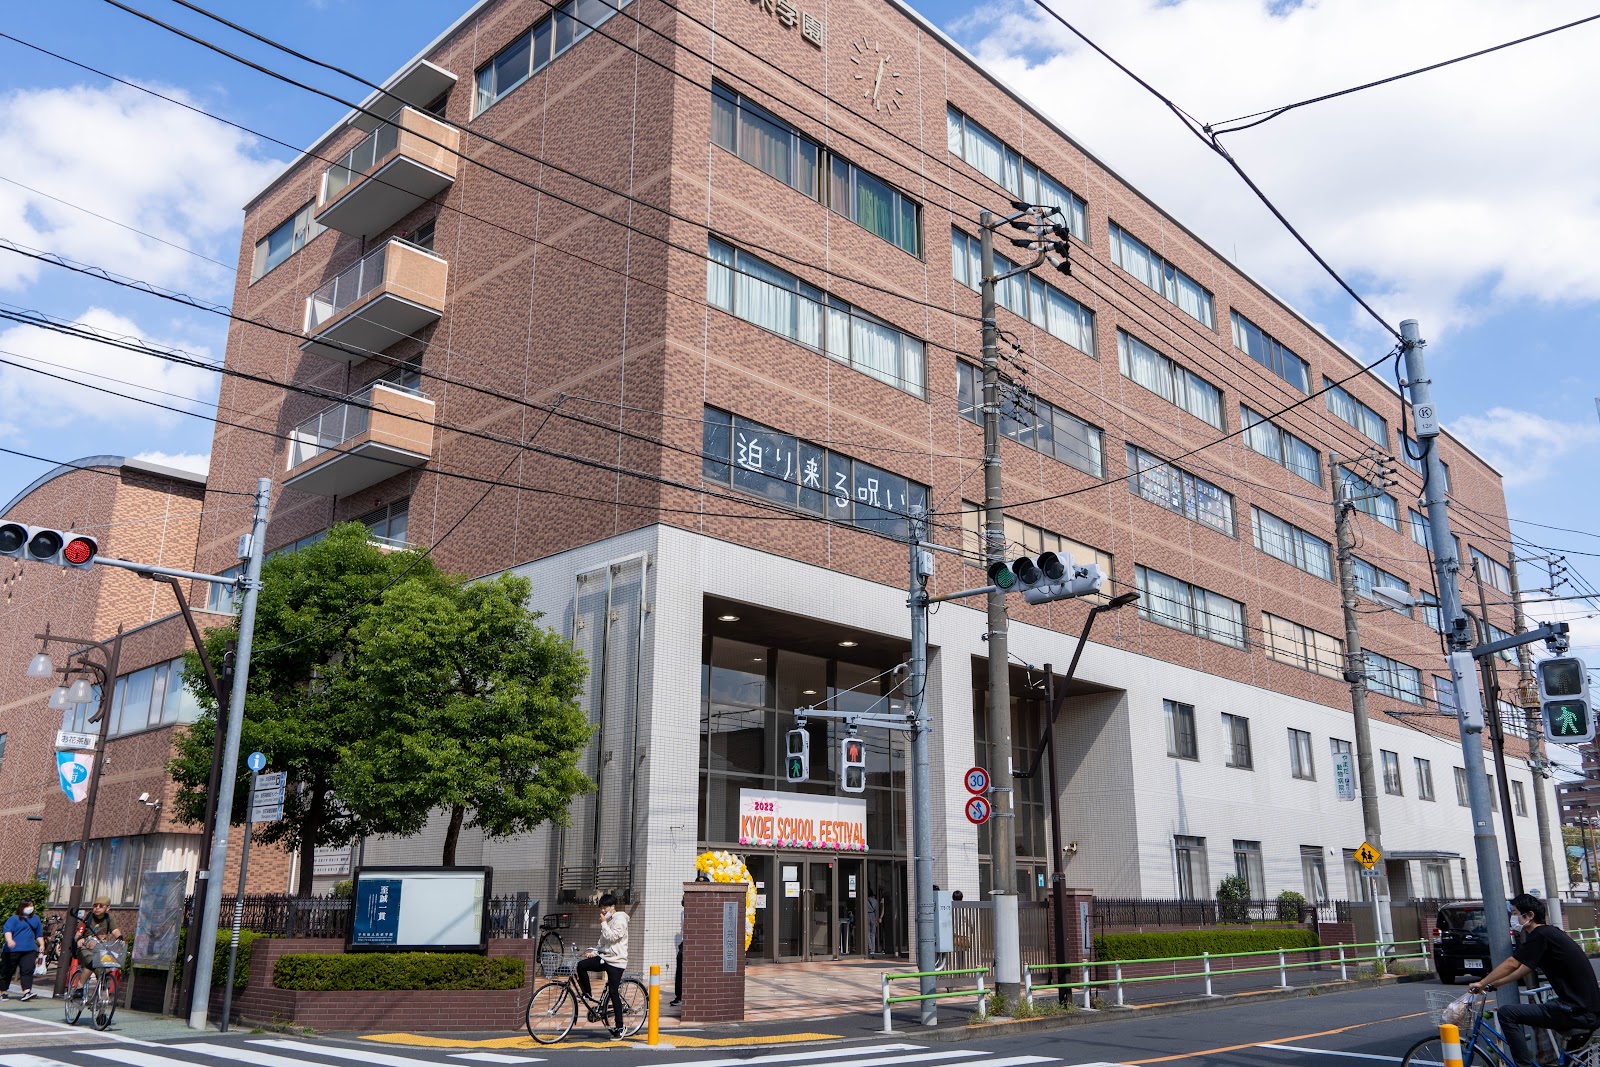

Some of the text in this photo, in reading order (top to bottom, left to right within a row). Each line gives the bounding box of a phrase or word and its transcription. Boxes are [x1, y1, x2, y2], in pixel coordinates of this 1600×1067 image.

[737, 432, 905, 510] 迫り来る呪い
[61, 735, 92, 746] お花茶屋
[1341, 755, 1350, 775] やまだ
[970, 774, 984, 787] 30
[754, 801, 774, 812] 2022
[741, 814, 866, 845] KYOEI SCHOOL FESTIVAL
